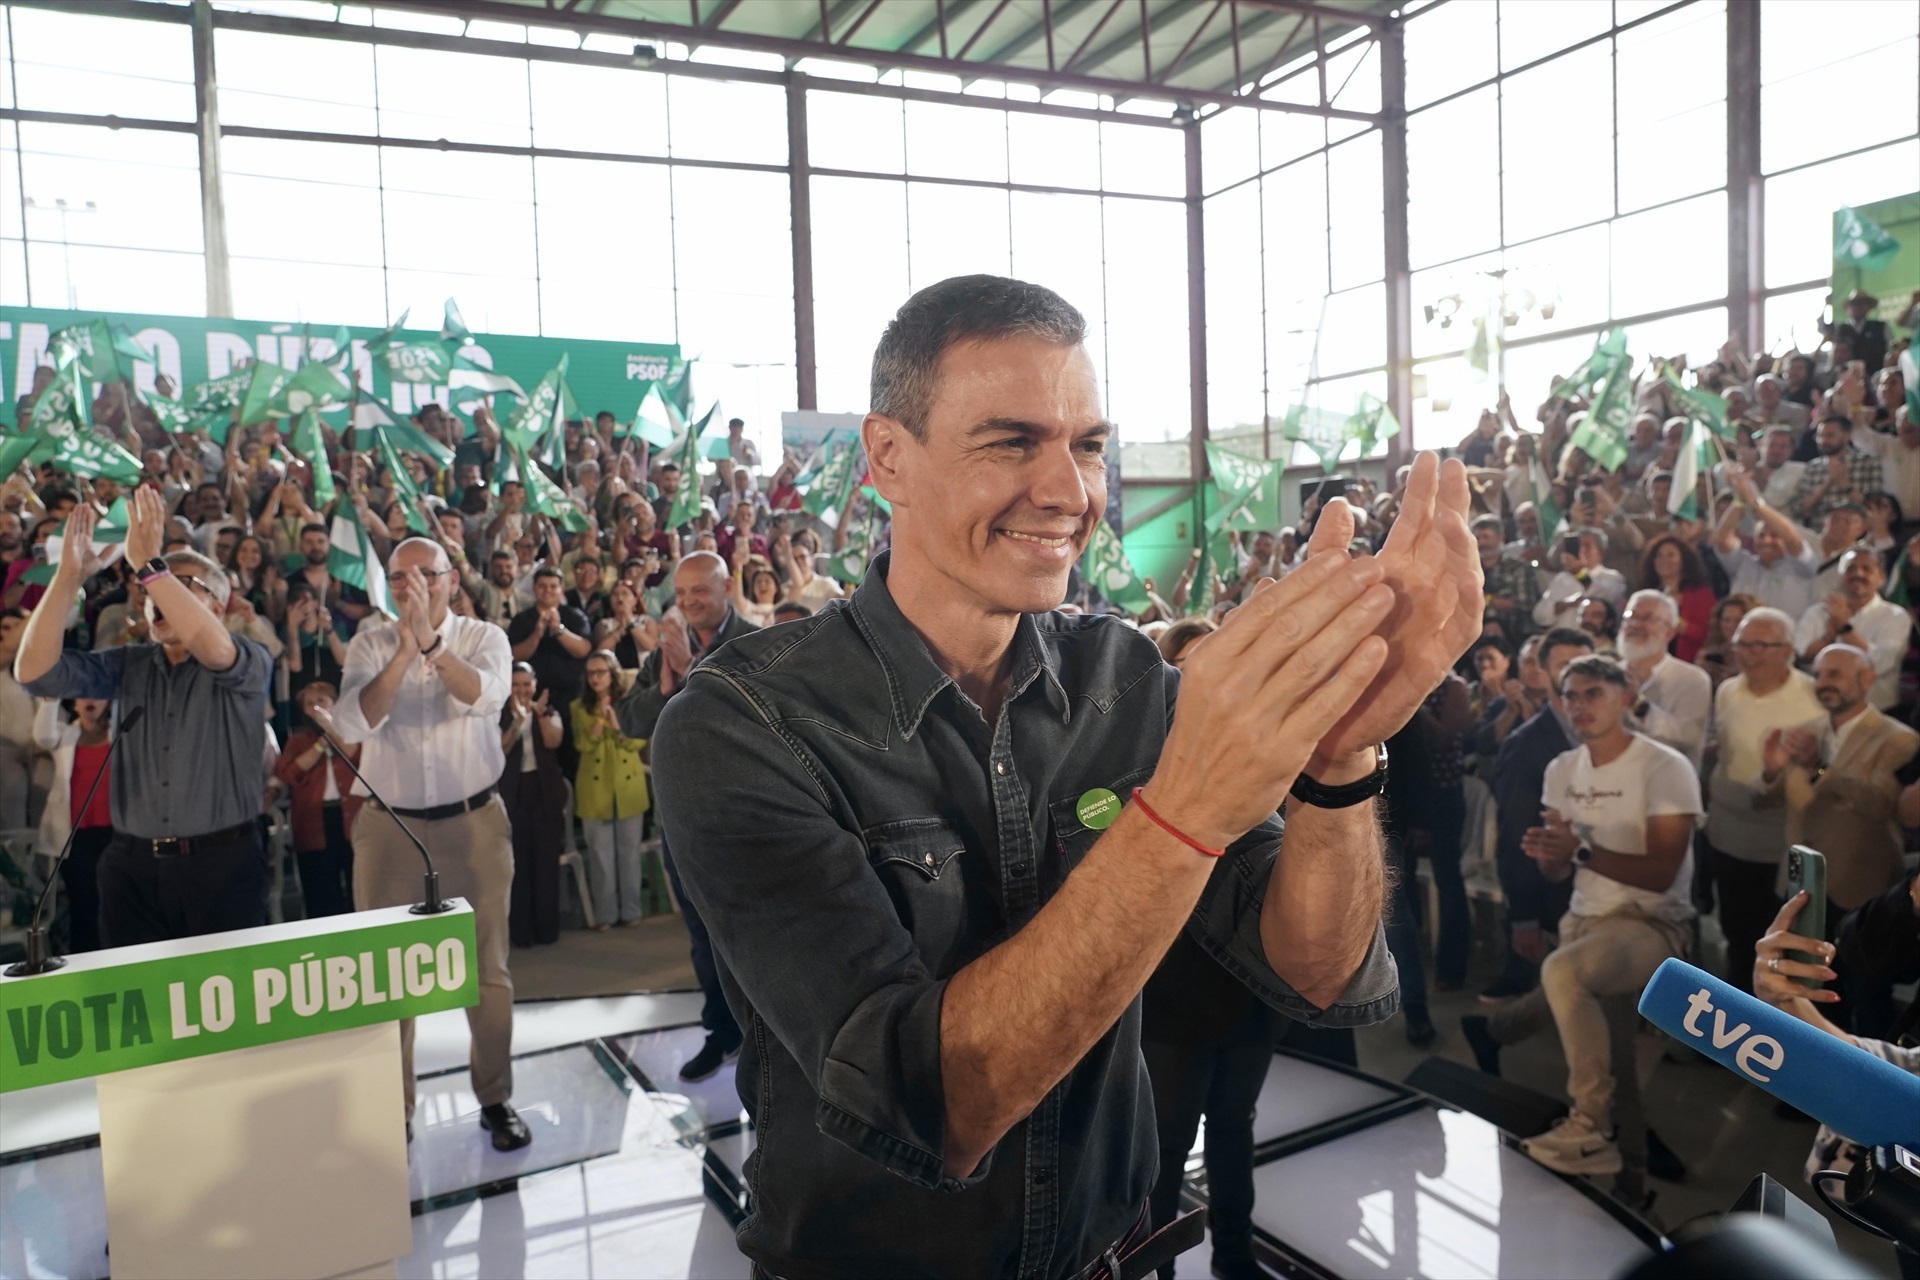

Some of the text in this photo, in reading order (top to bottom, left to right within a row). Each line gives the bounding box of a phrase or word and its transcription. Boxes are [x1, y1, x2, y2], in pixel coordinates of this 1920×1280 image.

[1080, 799, 1107, 815] DEFIENDE
[7, 937, 468, 1066] VOTA LO PÚBLICO
[1682, 988, 1785, 1083] tve
